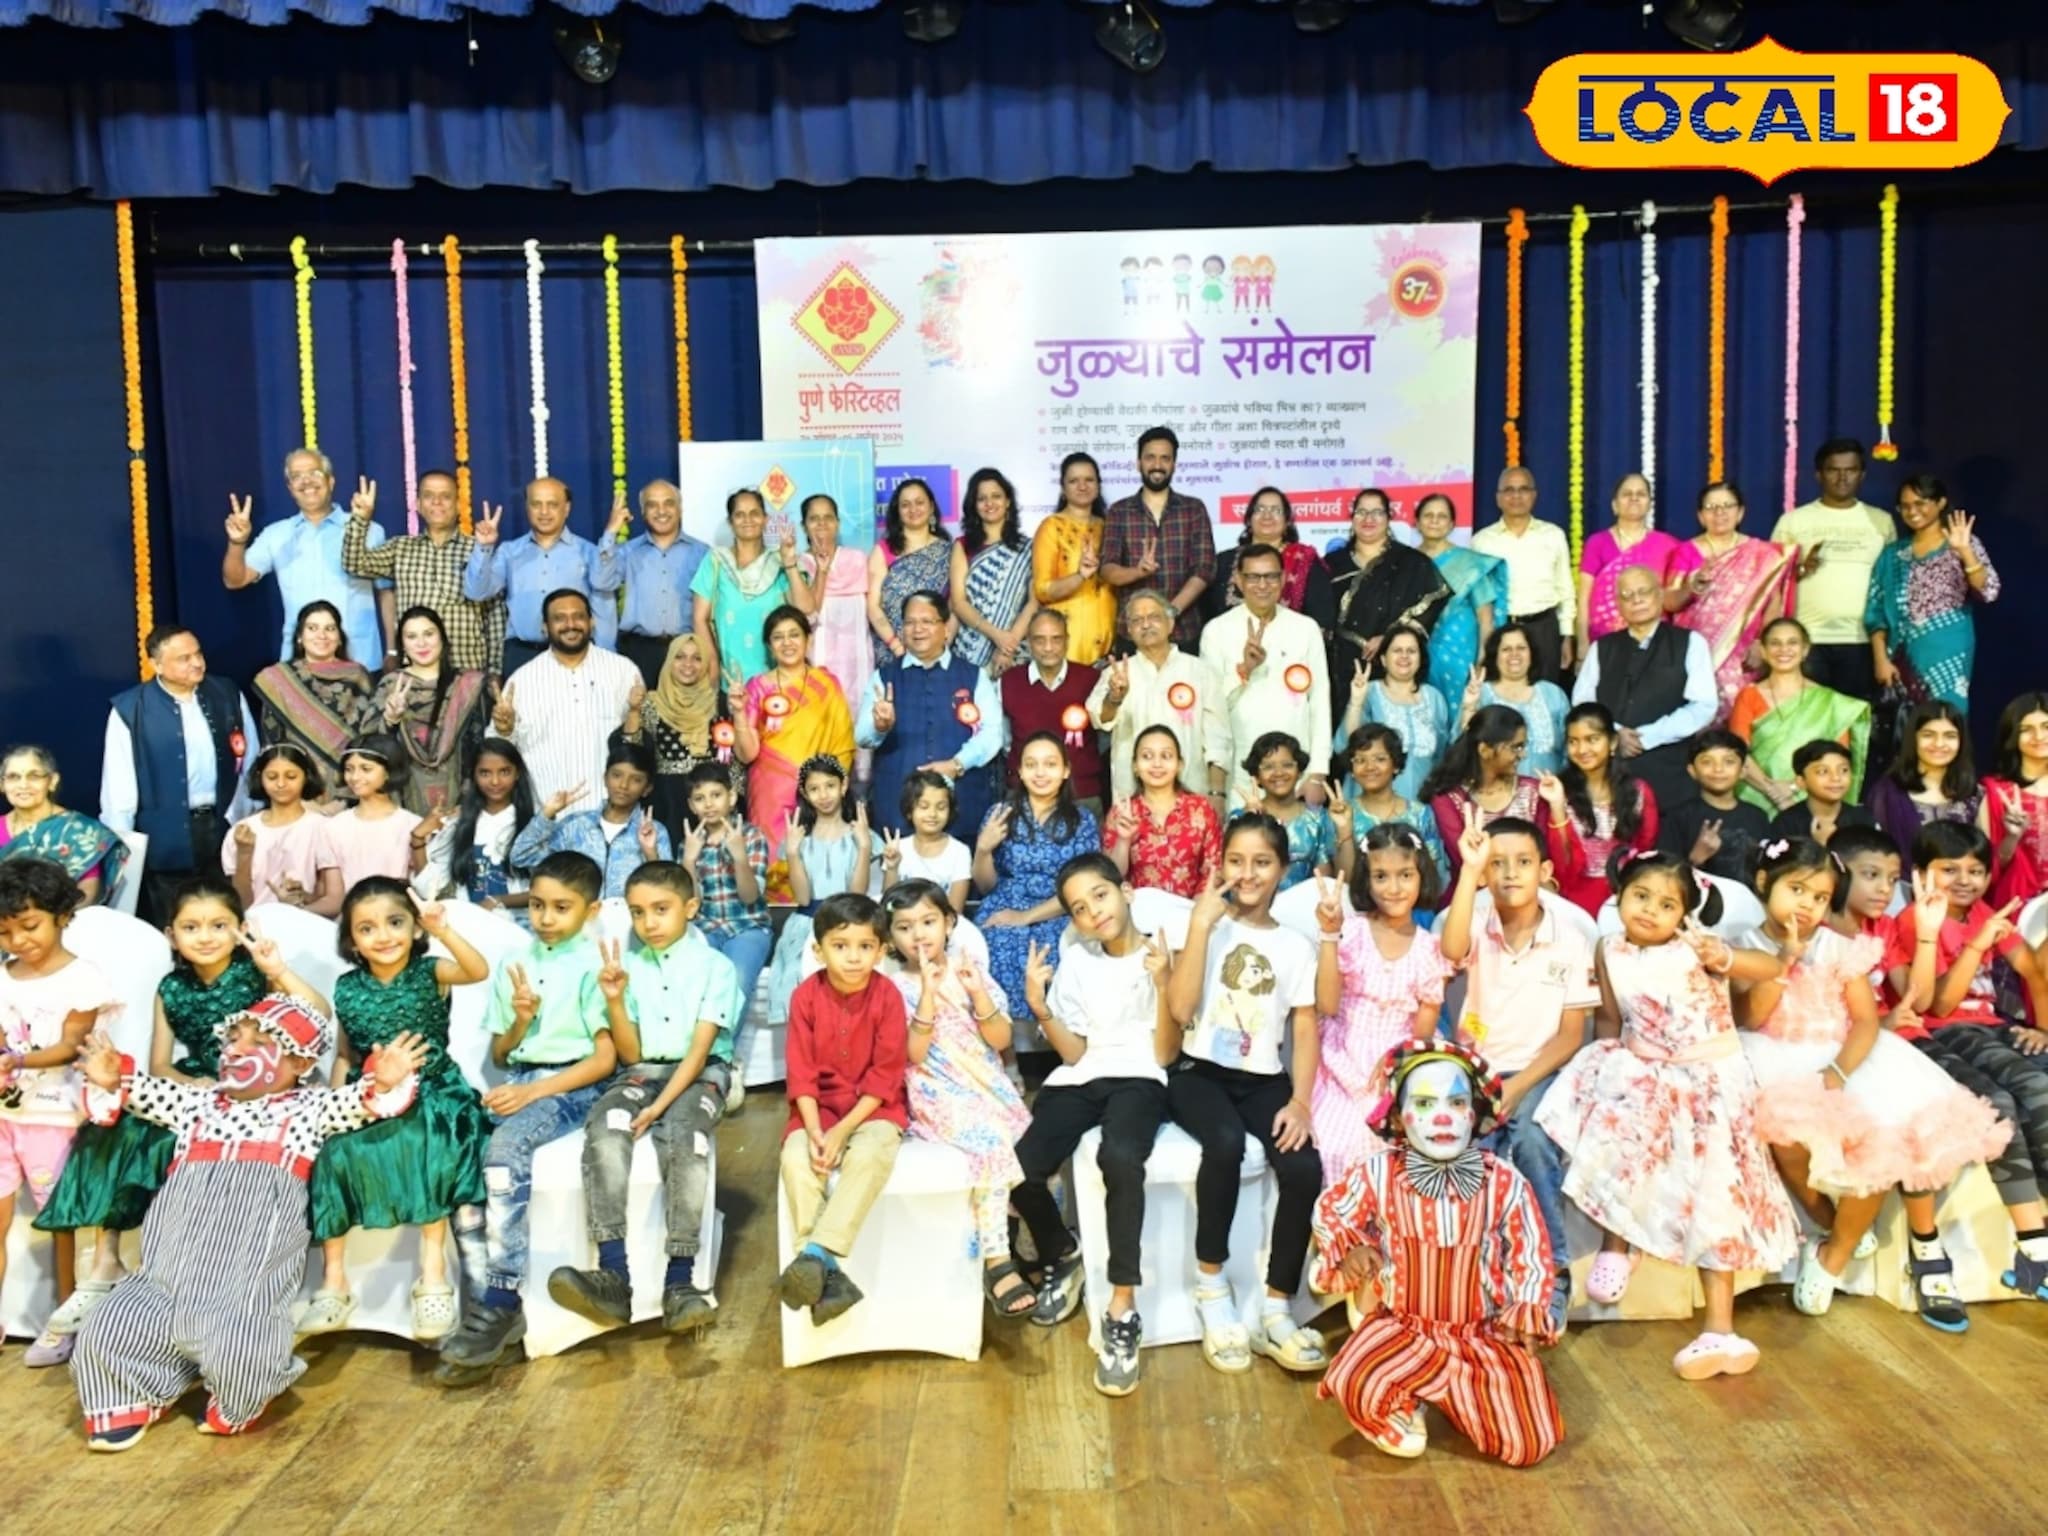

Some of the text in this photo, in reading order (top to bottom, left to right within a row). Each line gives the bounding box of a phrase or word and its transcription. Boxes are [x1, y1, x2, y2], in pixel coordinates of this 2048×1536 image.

[1220, 317, 1376, 379] संमेलन
[798, 382, 902, 423] पुणे फेस्टिव्हल
